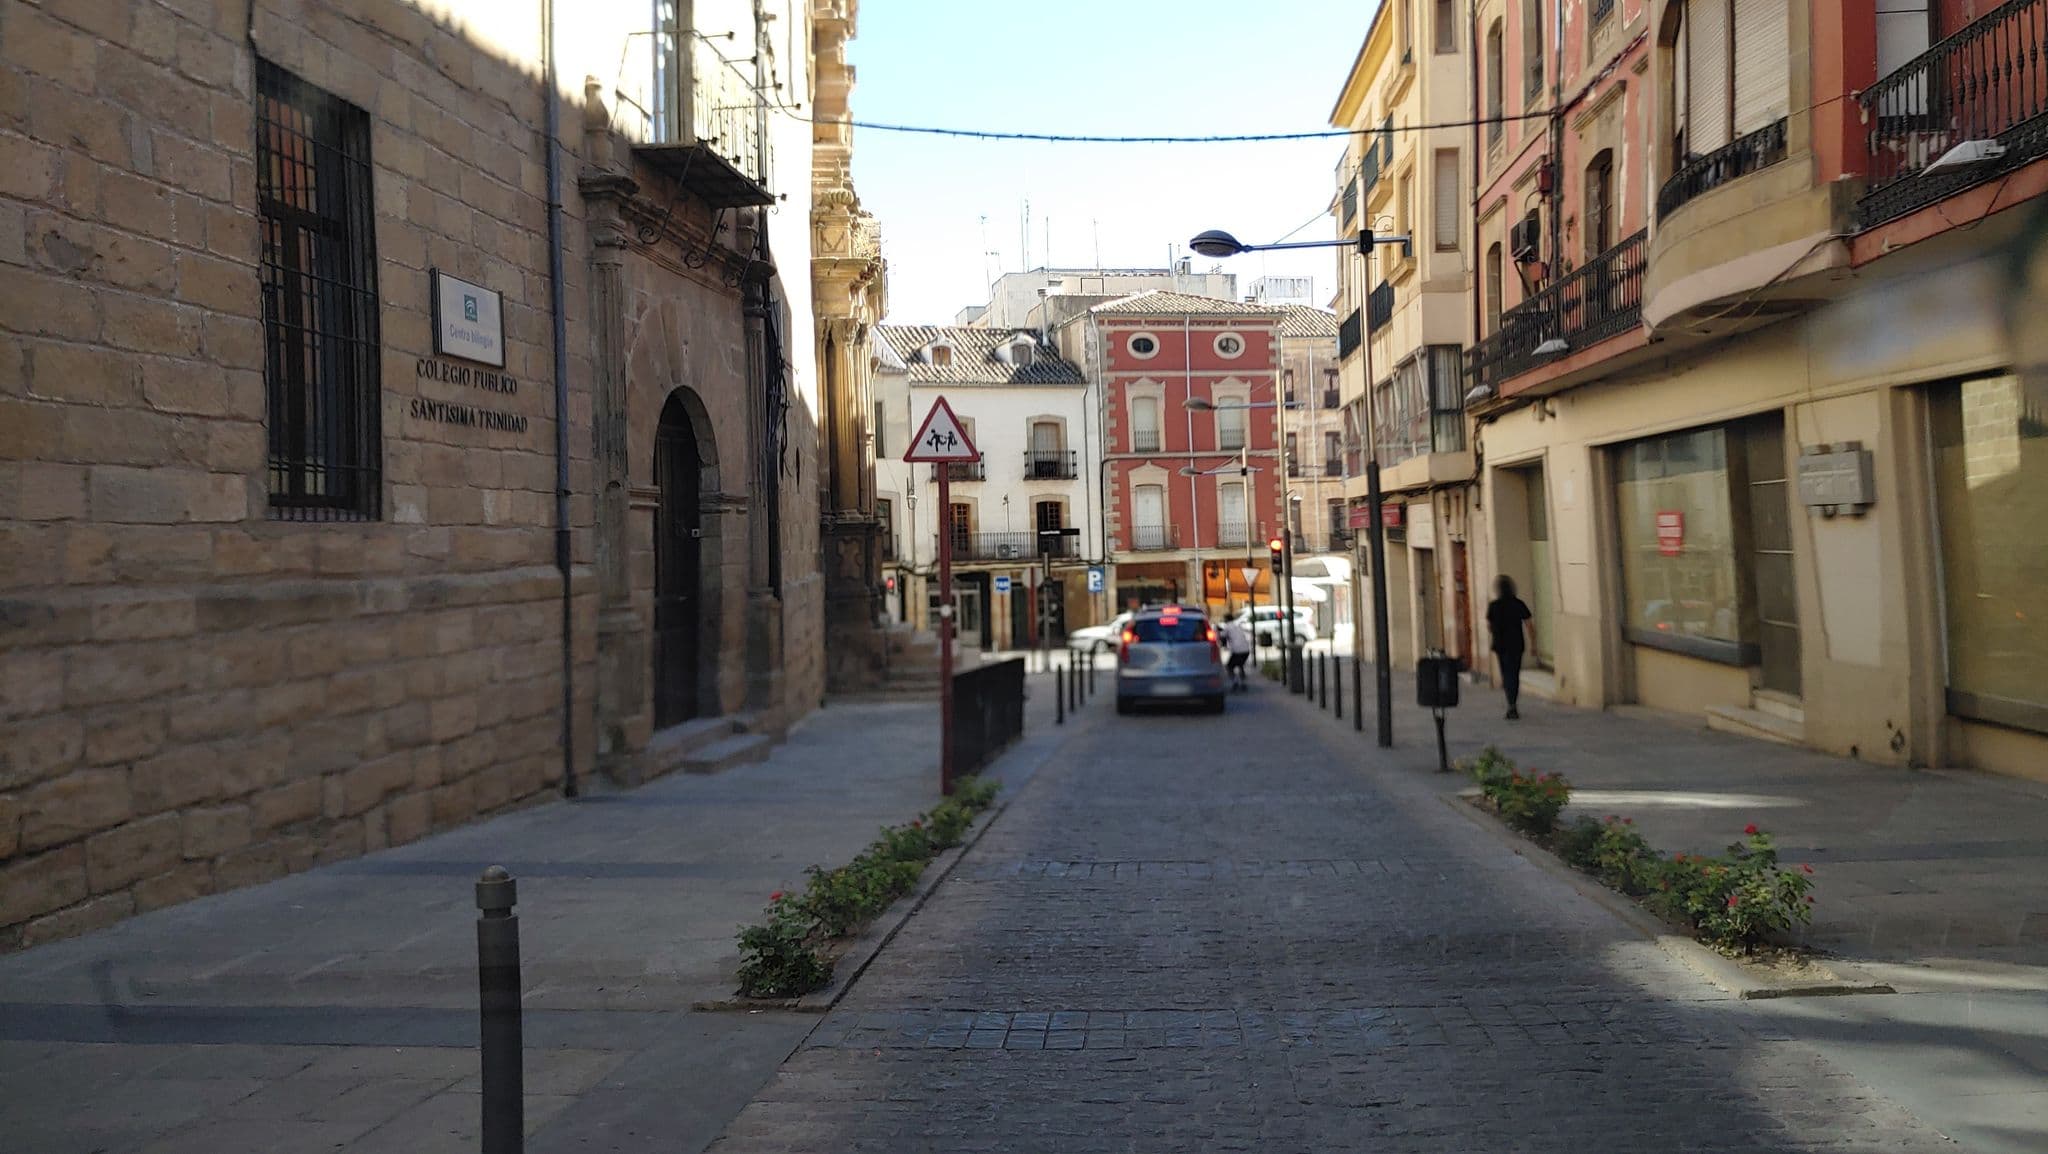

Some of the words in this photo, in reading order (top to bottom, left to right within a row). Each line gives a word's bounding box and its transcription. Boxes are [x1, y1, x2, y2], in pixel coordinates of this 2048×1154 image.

[416, 359, 470, 386] COLEGIO
[411, 398, 475, 428] SANTISIMA
[478, 409, 528, 433] TRINIDAD
[1088, 570, 1101, 591] P
